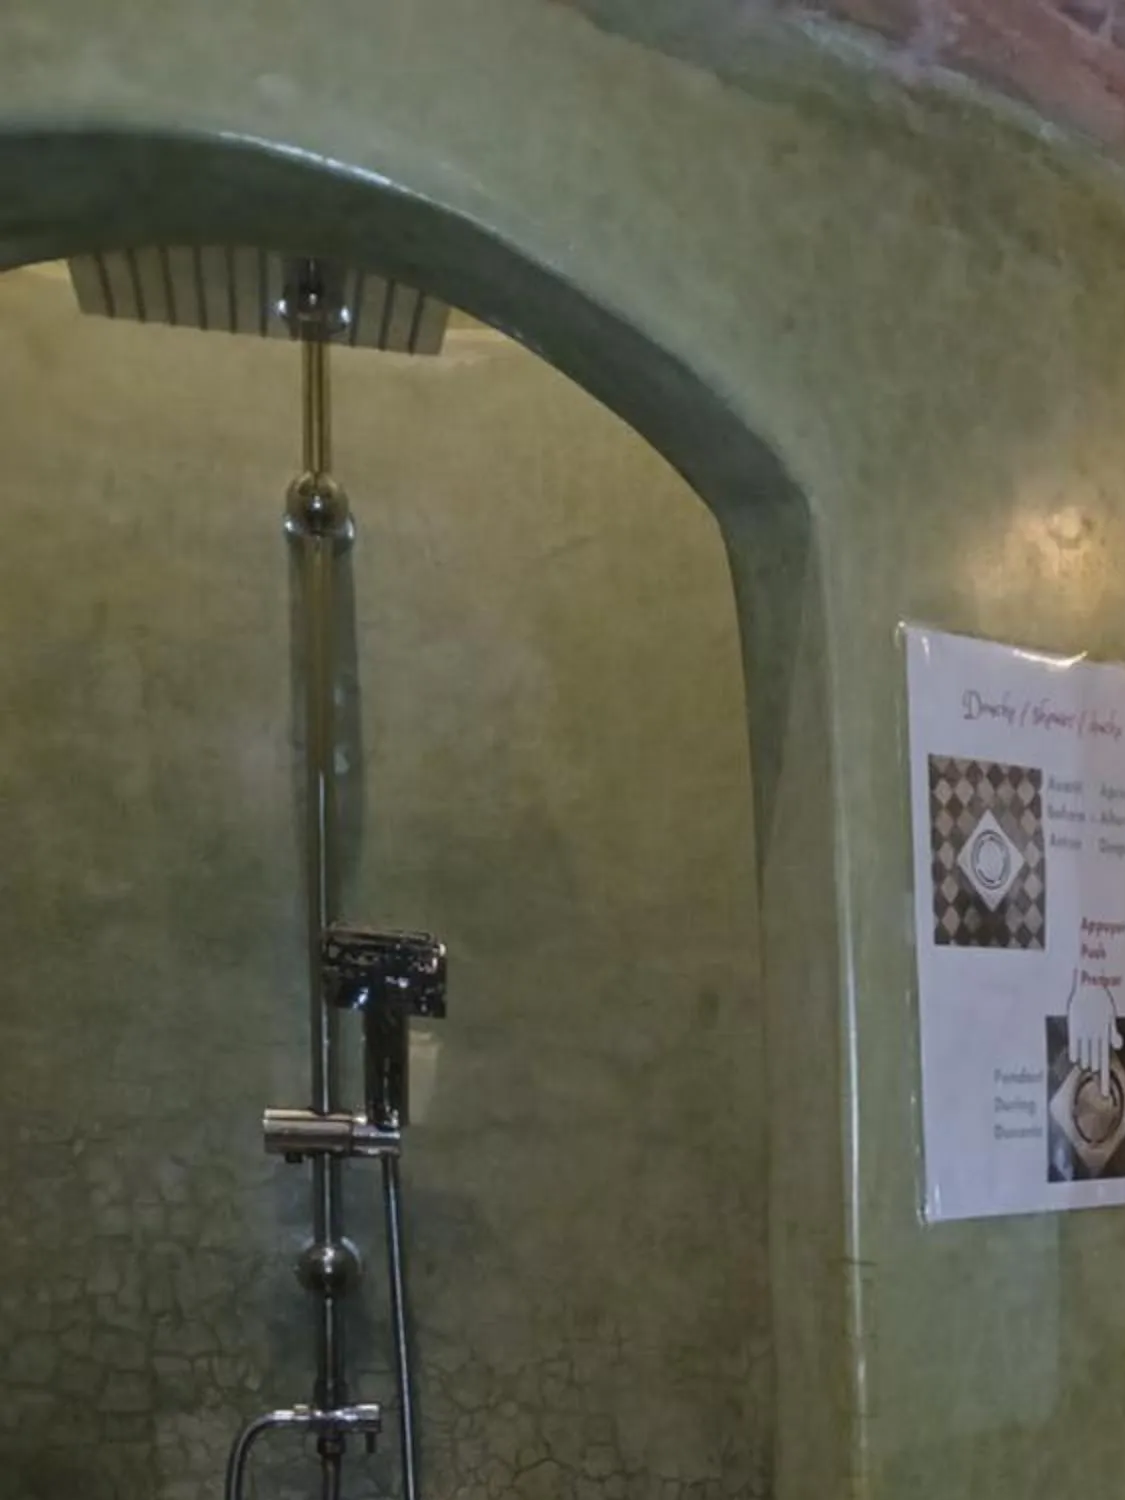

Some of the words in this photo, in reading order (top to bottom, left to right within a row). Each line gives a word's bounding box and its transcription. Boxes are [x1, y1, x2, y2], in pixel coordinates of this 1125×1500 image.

[1047, 803, 1086, 822] Before
[1080, 942, 1107, 960] Push
[993, 1096, 1036, 1117] During
